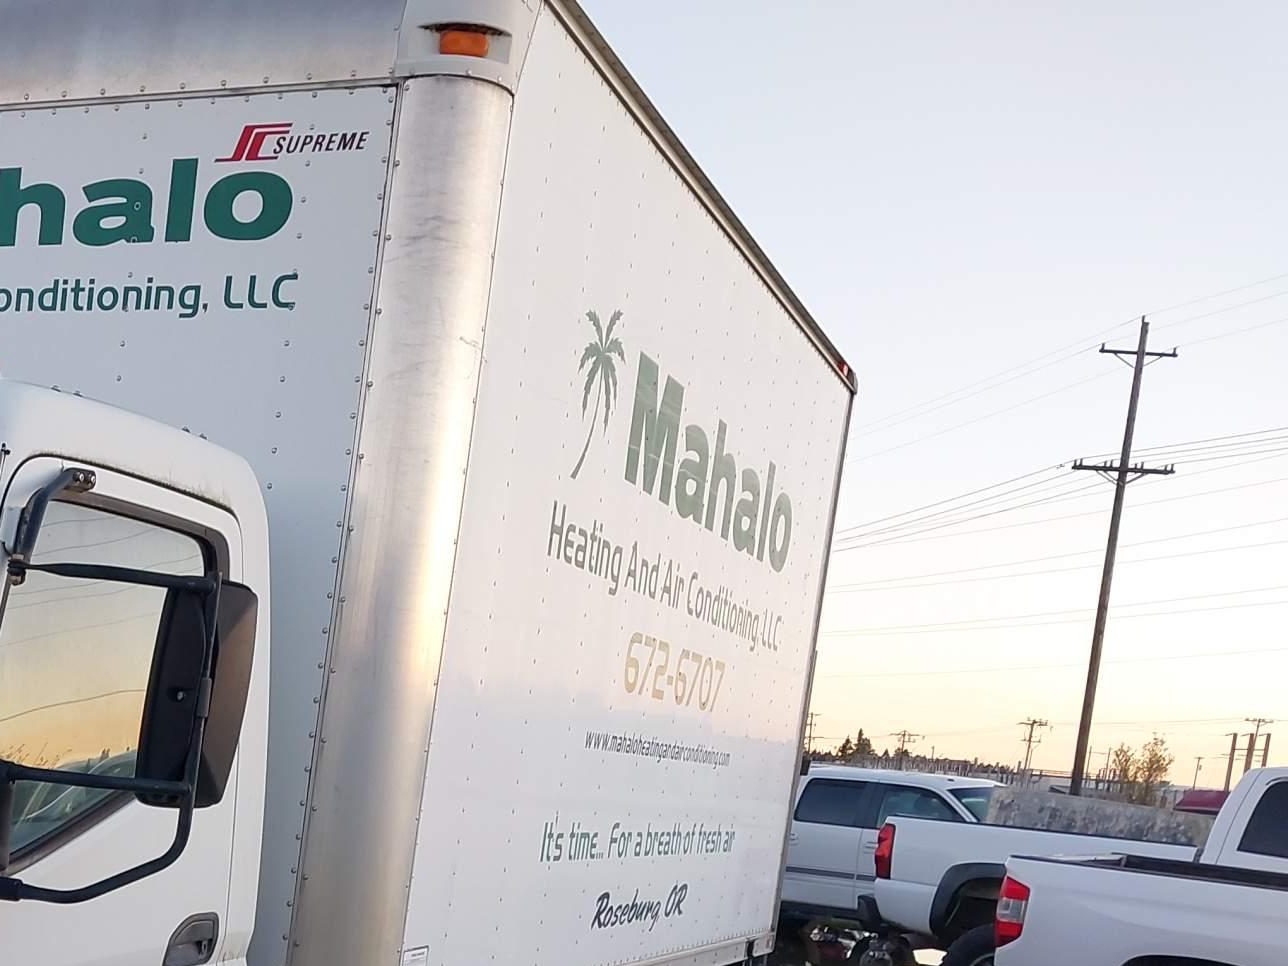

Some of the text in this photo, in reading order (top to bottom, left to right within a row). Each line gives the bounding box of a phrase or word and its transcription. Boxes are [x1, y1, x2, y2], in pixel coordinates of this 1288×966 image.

[273, 131, 370, 155] SUPREME
[223, 273, 299, 310] LLC
[624, 350, 793, 574] Mahalo
[547, 499, 623, 597] Heating
[624, 540, 661, 600] And
[660, 559, 685, 610] Air
[761, 608, 783, 652] LLC
[624, 631, 726, 713] 672-6707
[540, 814, 565, 862] It's
[607, 822, 632, 858] For
[634, 831, 643, 857] a
[644, 822, 683, 857] breath
[683, 823, 697, 855] of
[696, 823, 723, 855] fresh
[723, 823, 736, 853] air
[590, 883, 689, 932] Roseburg OR
